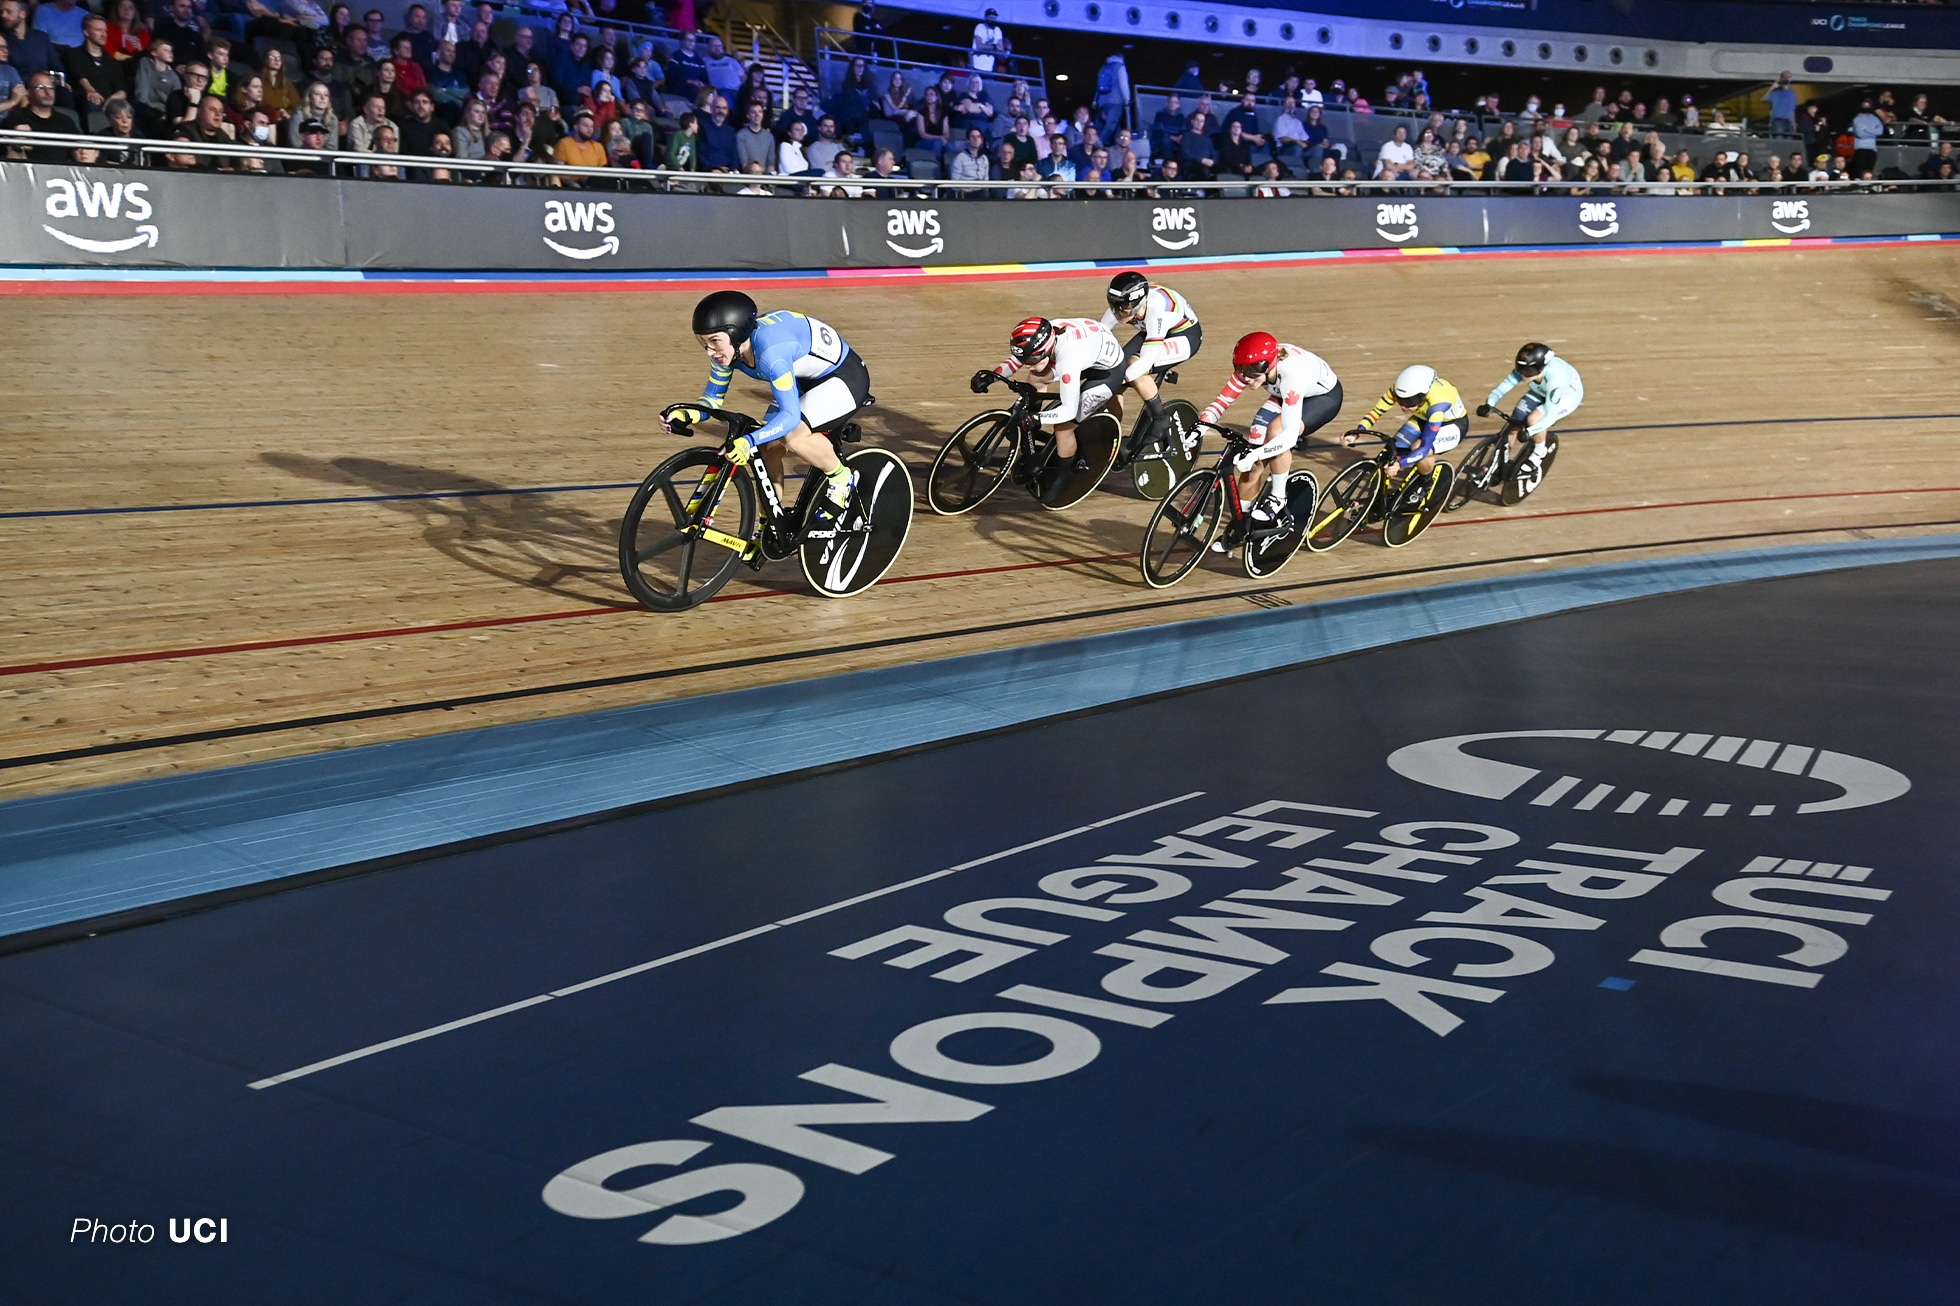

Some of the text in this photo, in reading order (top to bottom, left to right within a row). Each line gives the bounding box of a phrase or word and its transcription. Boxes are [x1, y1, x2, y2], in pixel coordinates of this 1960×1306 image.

[46, 178, 152, 220] aws
[1773, 201, 1808, 219] aws
[545, 201, 615, 232] aws
[888, 209, 940, 235] aws
[1153, 207, 1196, 231] aws
[1377, 204, 1416, 225] aws
[1580, 202, 1617, 222] aws
[820, 327, 832, 346] 6
[1033, 332, 1048, 349] JAPAN
[1105, 340, 1117, 358] 17
[758, 423, 784, 440] Santini
[1264, 443, 1283, 454] Santini
[749, 446, 784, 518] LOOK
[826, 800, 1380, 983] LEAGUE
[1262, 842, 1704, 1037] TRACK
[1628, 876, 1893, 988] UCI
[541, 820, 1520, 1245] CHAMPIONS
